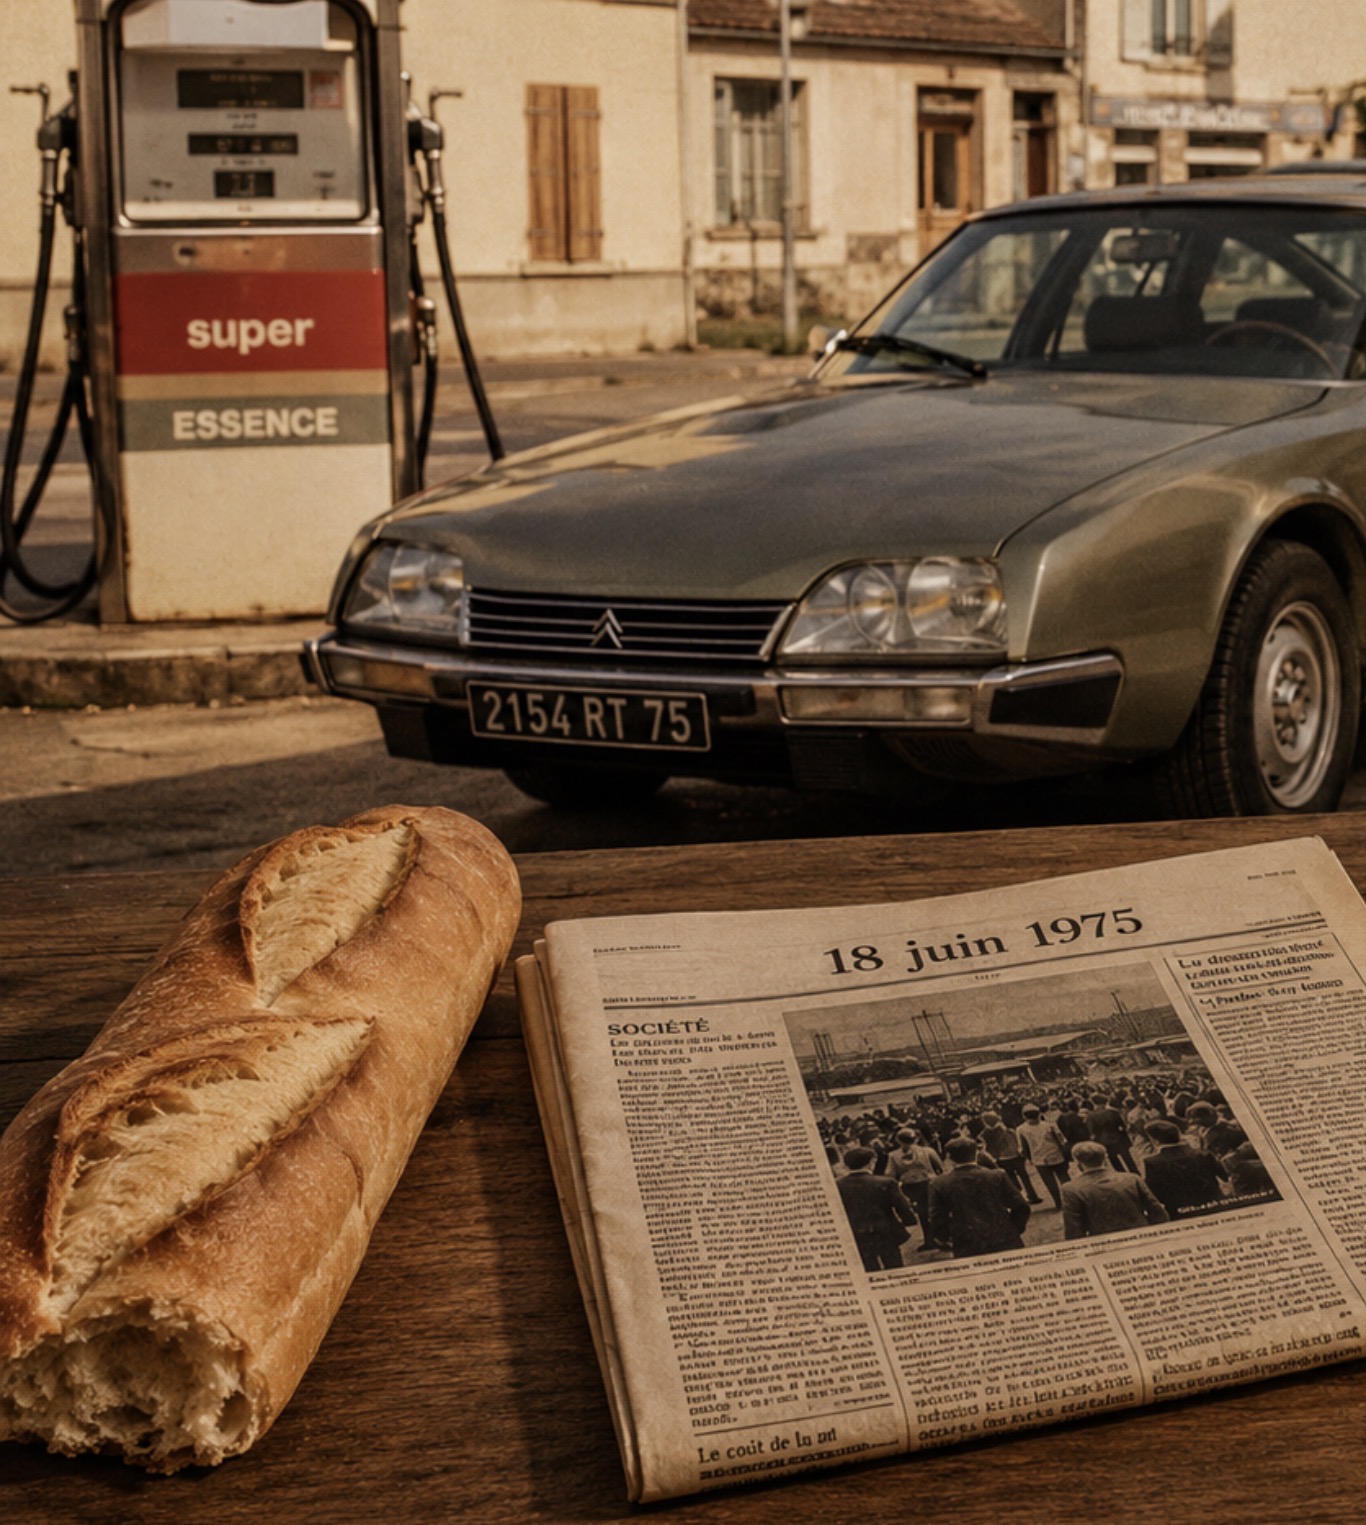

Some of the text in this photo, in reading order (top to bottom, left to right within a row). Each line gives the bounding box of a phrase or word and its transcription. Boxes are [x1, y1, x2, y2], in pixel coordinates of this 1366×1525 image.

[187, 318, 315, 355] super
[172, 407, 338, 441] ESSENCE
[483, 691, 692, 743] 2154 RT 75
[824, 907, 1143, 975] 18 juin 1975
[607, 1017, 710, 1036] SOCIÉTÉ
[697, 1446, 720, 1463] Le
[770, 1435, 790, 1452] de
